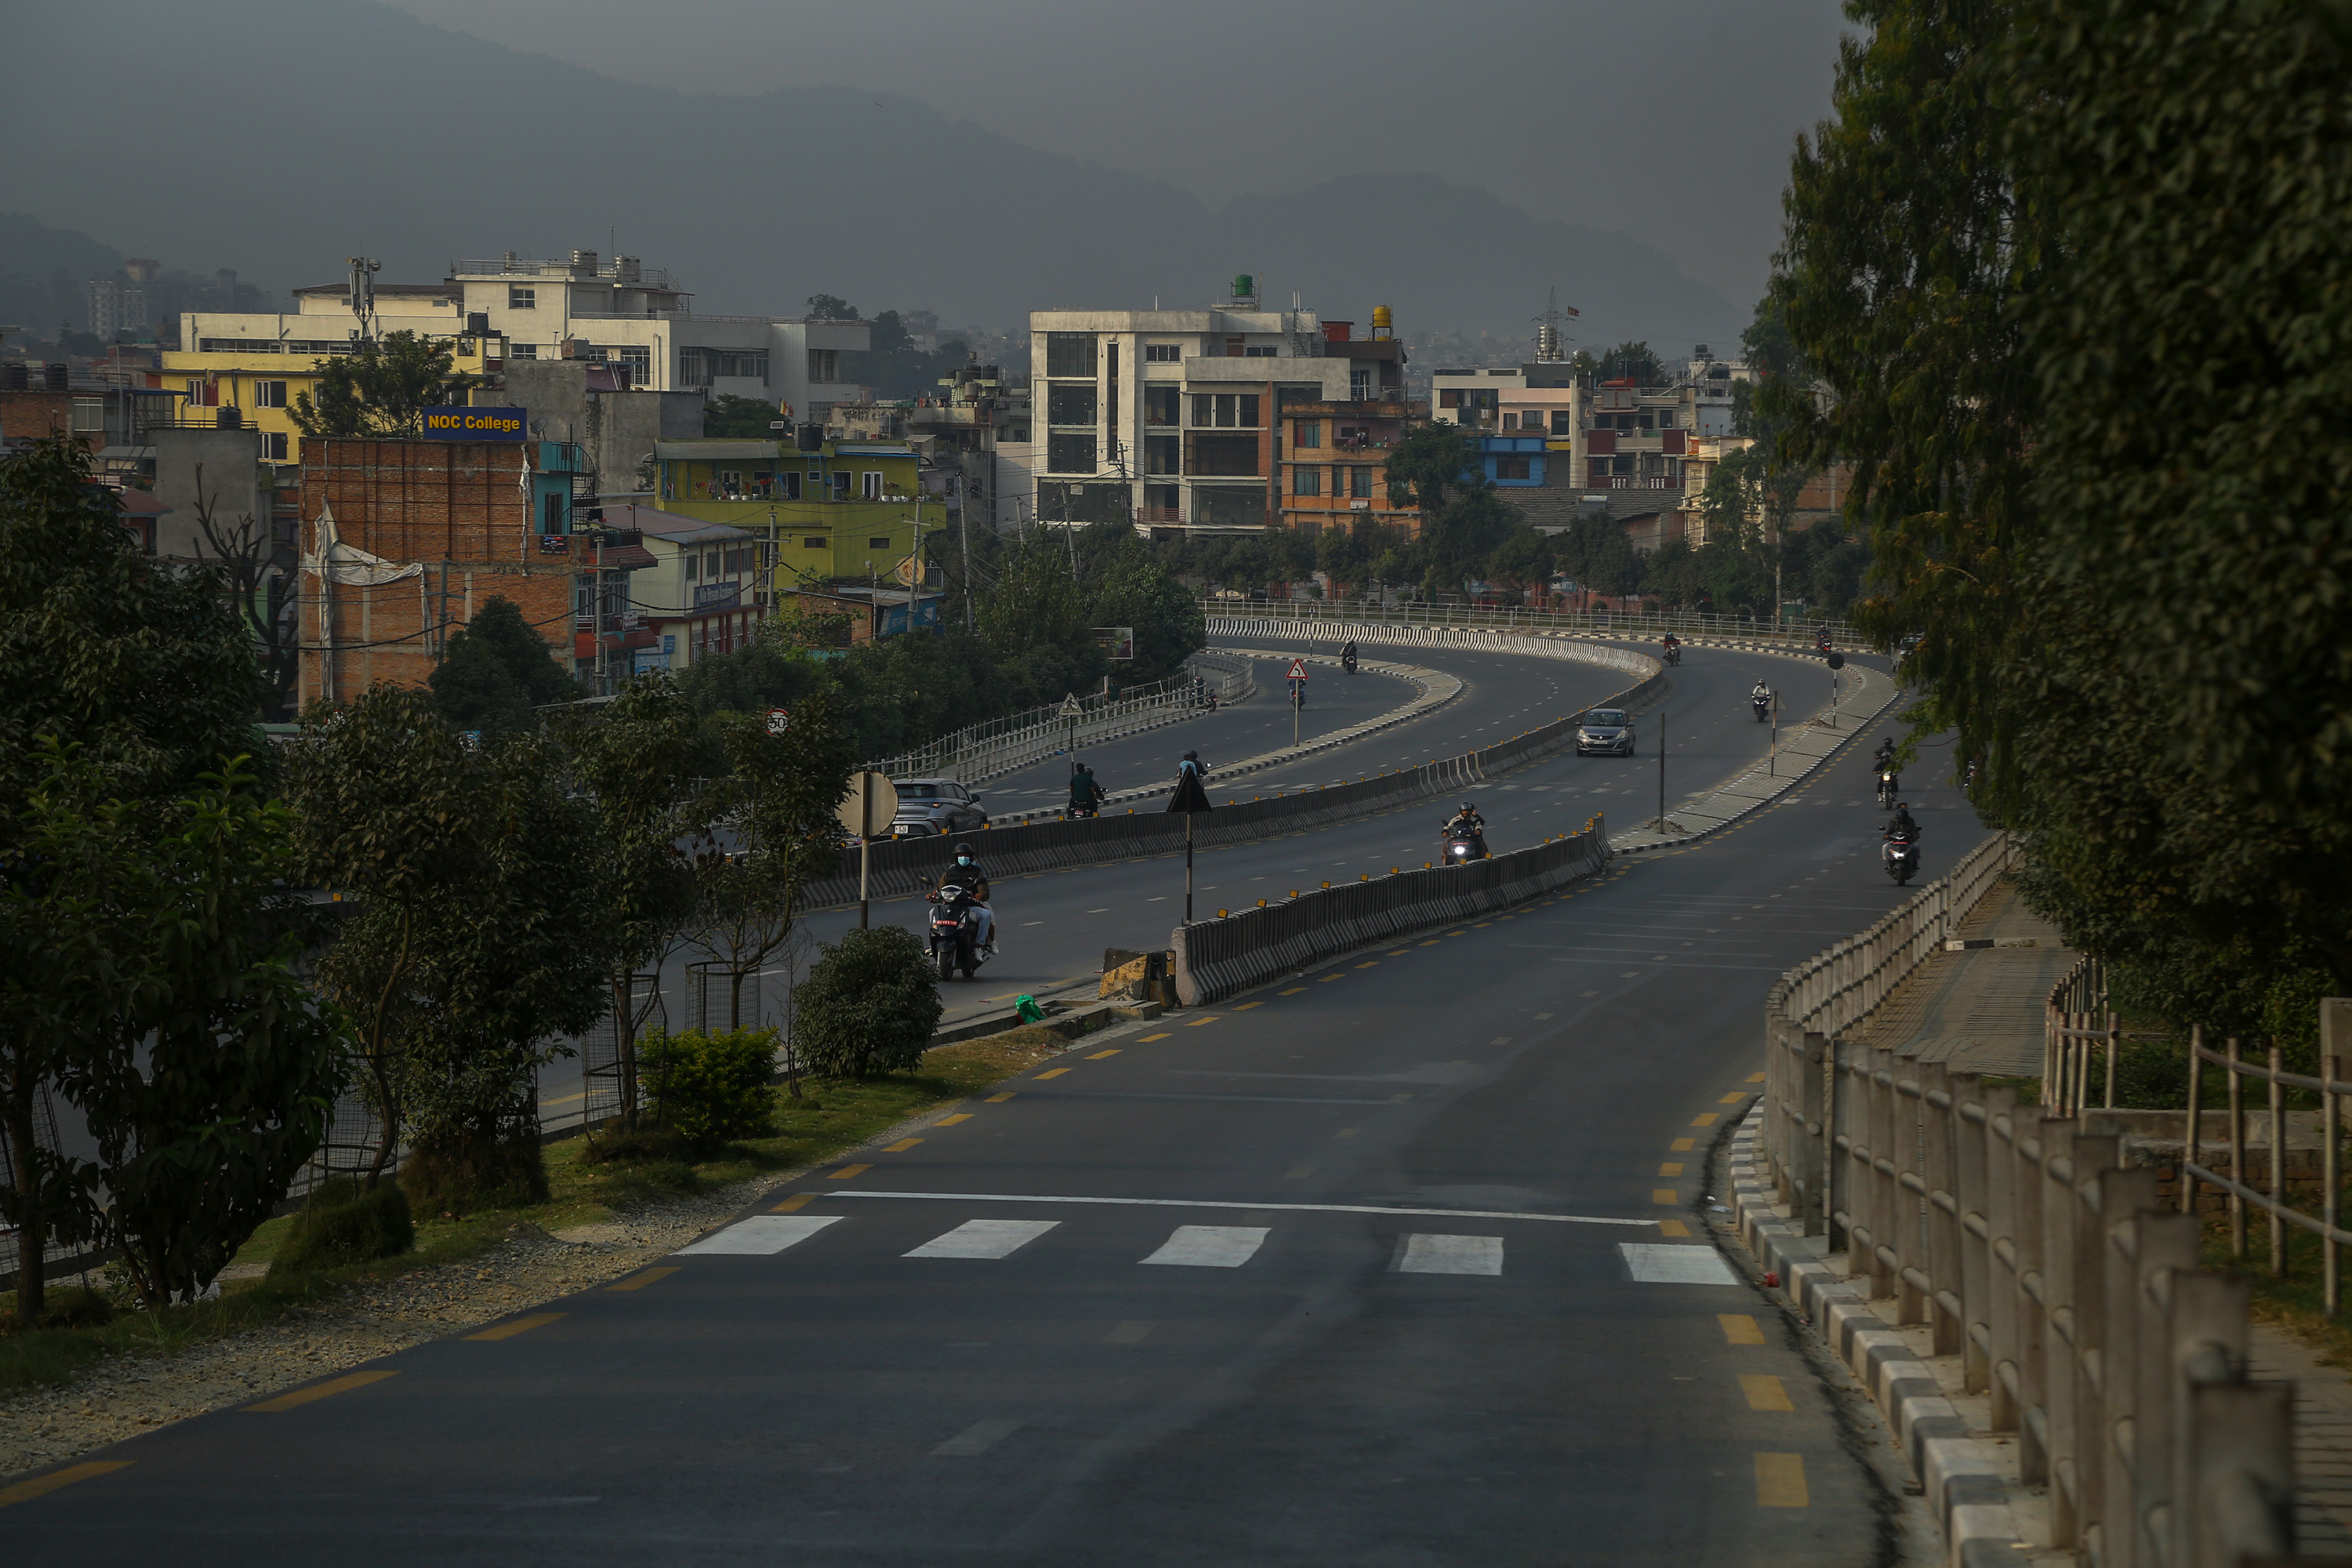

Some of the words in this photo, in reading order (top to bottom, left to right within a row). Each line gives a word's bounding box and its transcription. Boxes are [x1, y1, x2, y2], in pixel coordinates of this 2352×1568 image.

[428, 415, 461, 429] NOC
[465, 415, 521, 433] College
[768, 717, 786, 729] 50
